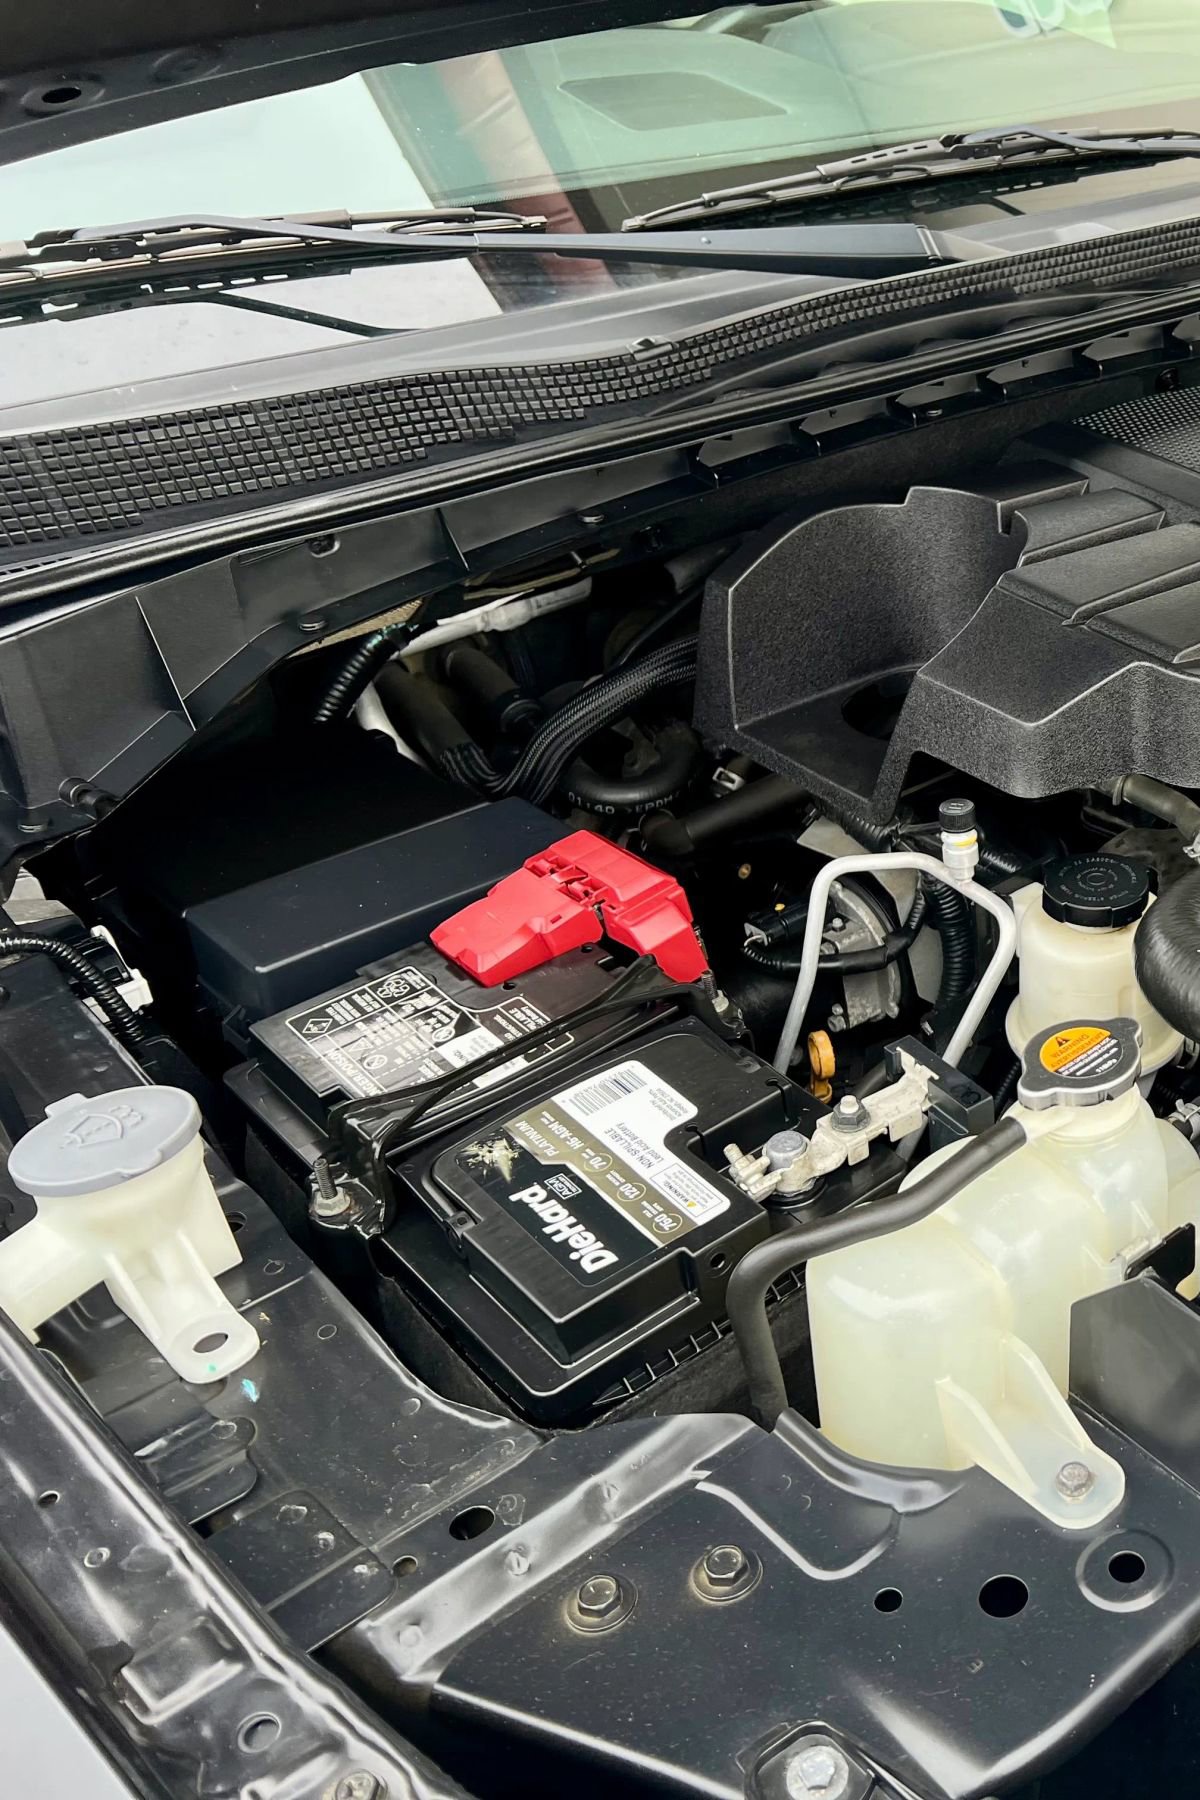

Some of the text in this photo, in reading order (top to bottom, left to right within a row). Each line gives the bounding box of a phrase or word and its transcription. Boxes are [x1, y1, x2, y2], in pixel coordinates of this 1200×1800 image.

[325, 1048, 381, 1094] NGER/POISON
[513, 1119, 559, 1156] PLATINUM
[547, 1120, 584, 1149] H6-AGM
[603, 1127, 654, 1168] NON-SPILLABLE
[614, 1121, 664, 1162] Lead Acid Battery
[588, 1156, 606, 1170] 70
[547, 1177, 572, 1197] AGM
[618, 1182, 640, 1198] 120
[507, 1180, 619, 1275] DieHard
[652, 1213, 677, 1232] 760
